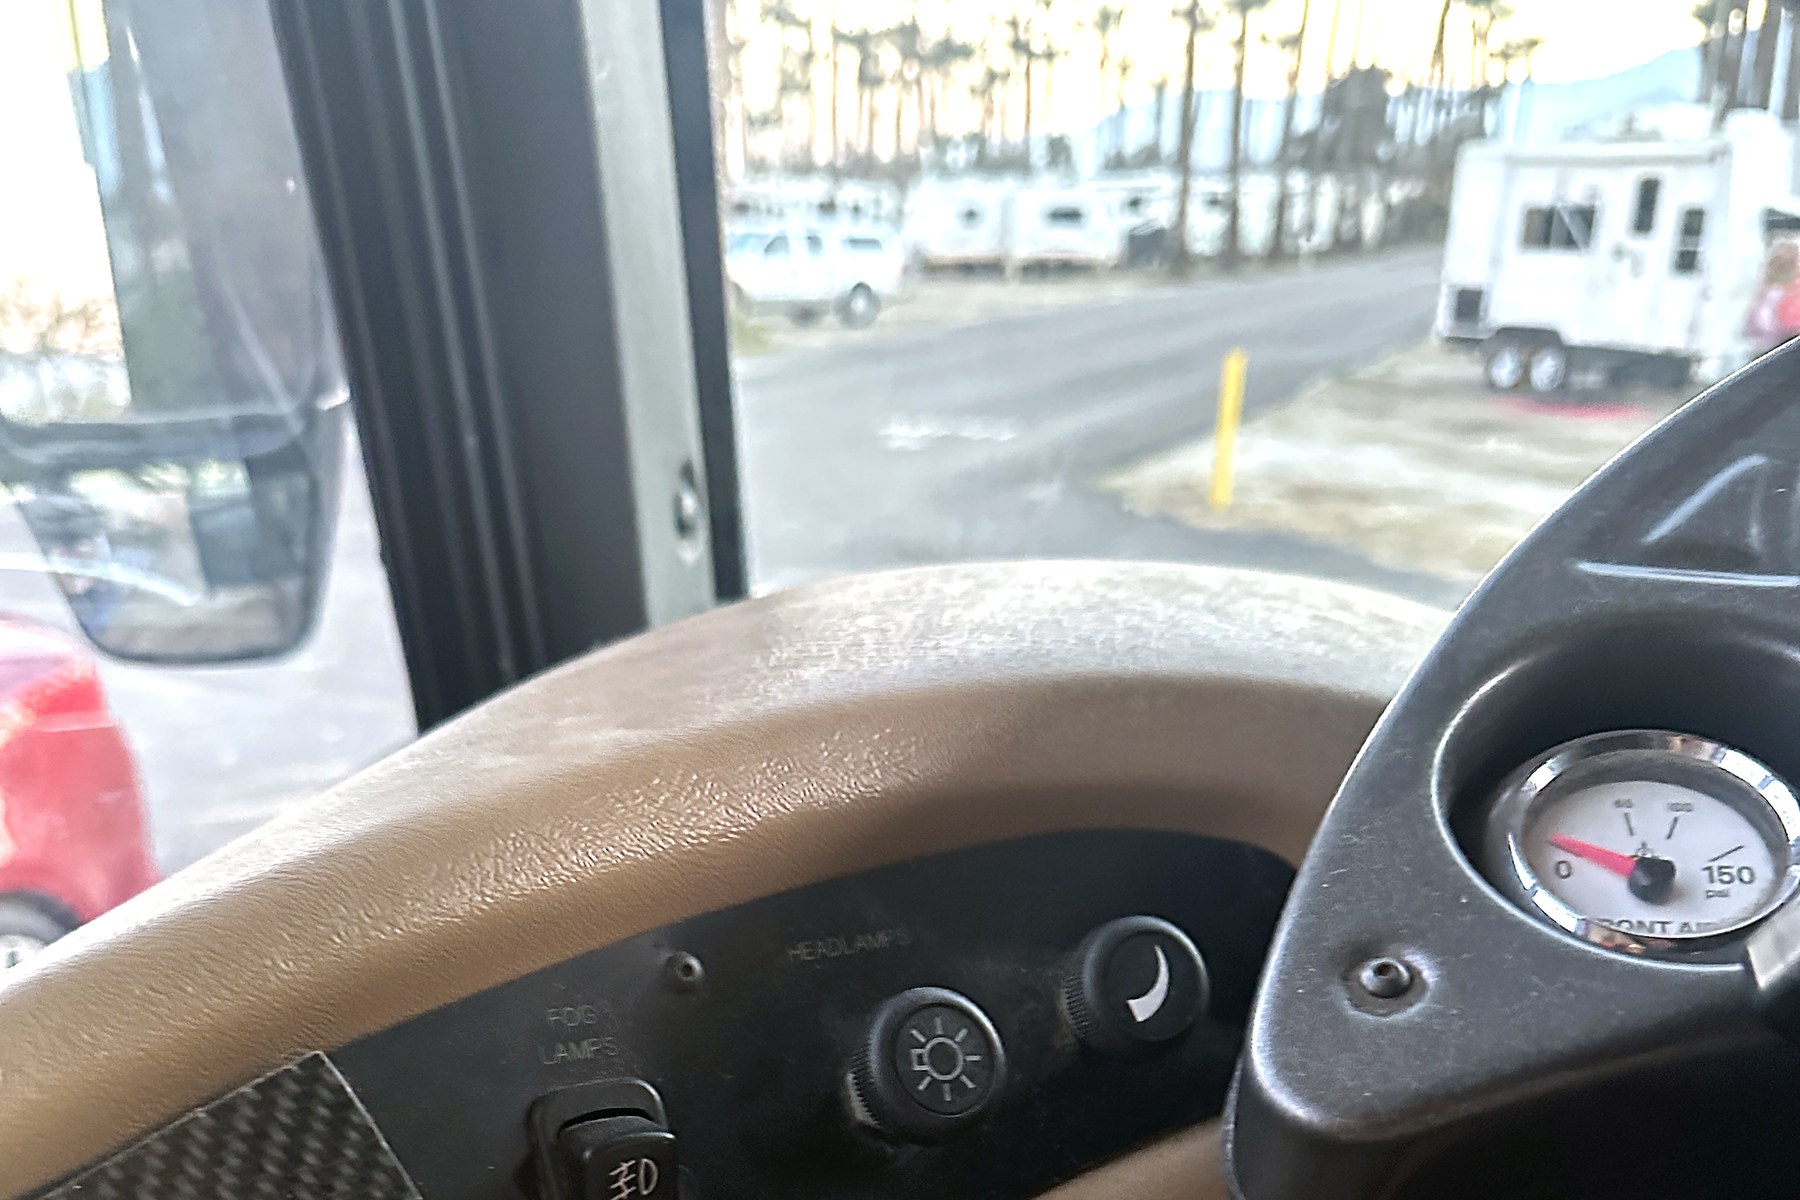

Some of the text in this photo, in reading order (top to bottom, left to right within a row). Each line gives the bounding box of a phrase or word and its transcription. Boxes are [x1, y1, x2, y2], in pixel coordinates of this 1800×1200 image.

[1555, 860, 1573, 879] 0
[1702, 865, 1754, 884] 150
[788, 928, 911, 961] HEADLAMPS
[546, 1005, 597, 1027] FOG
[539, 1036, 620, 1065] LAMPS
